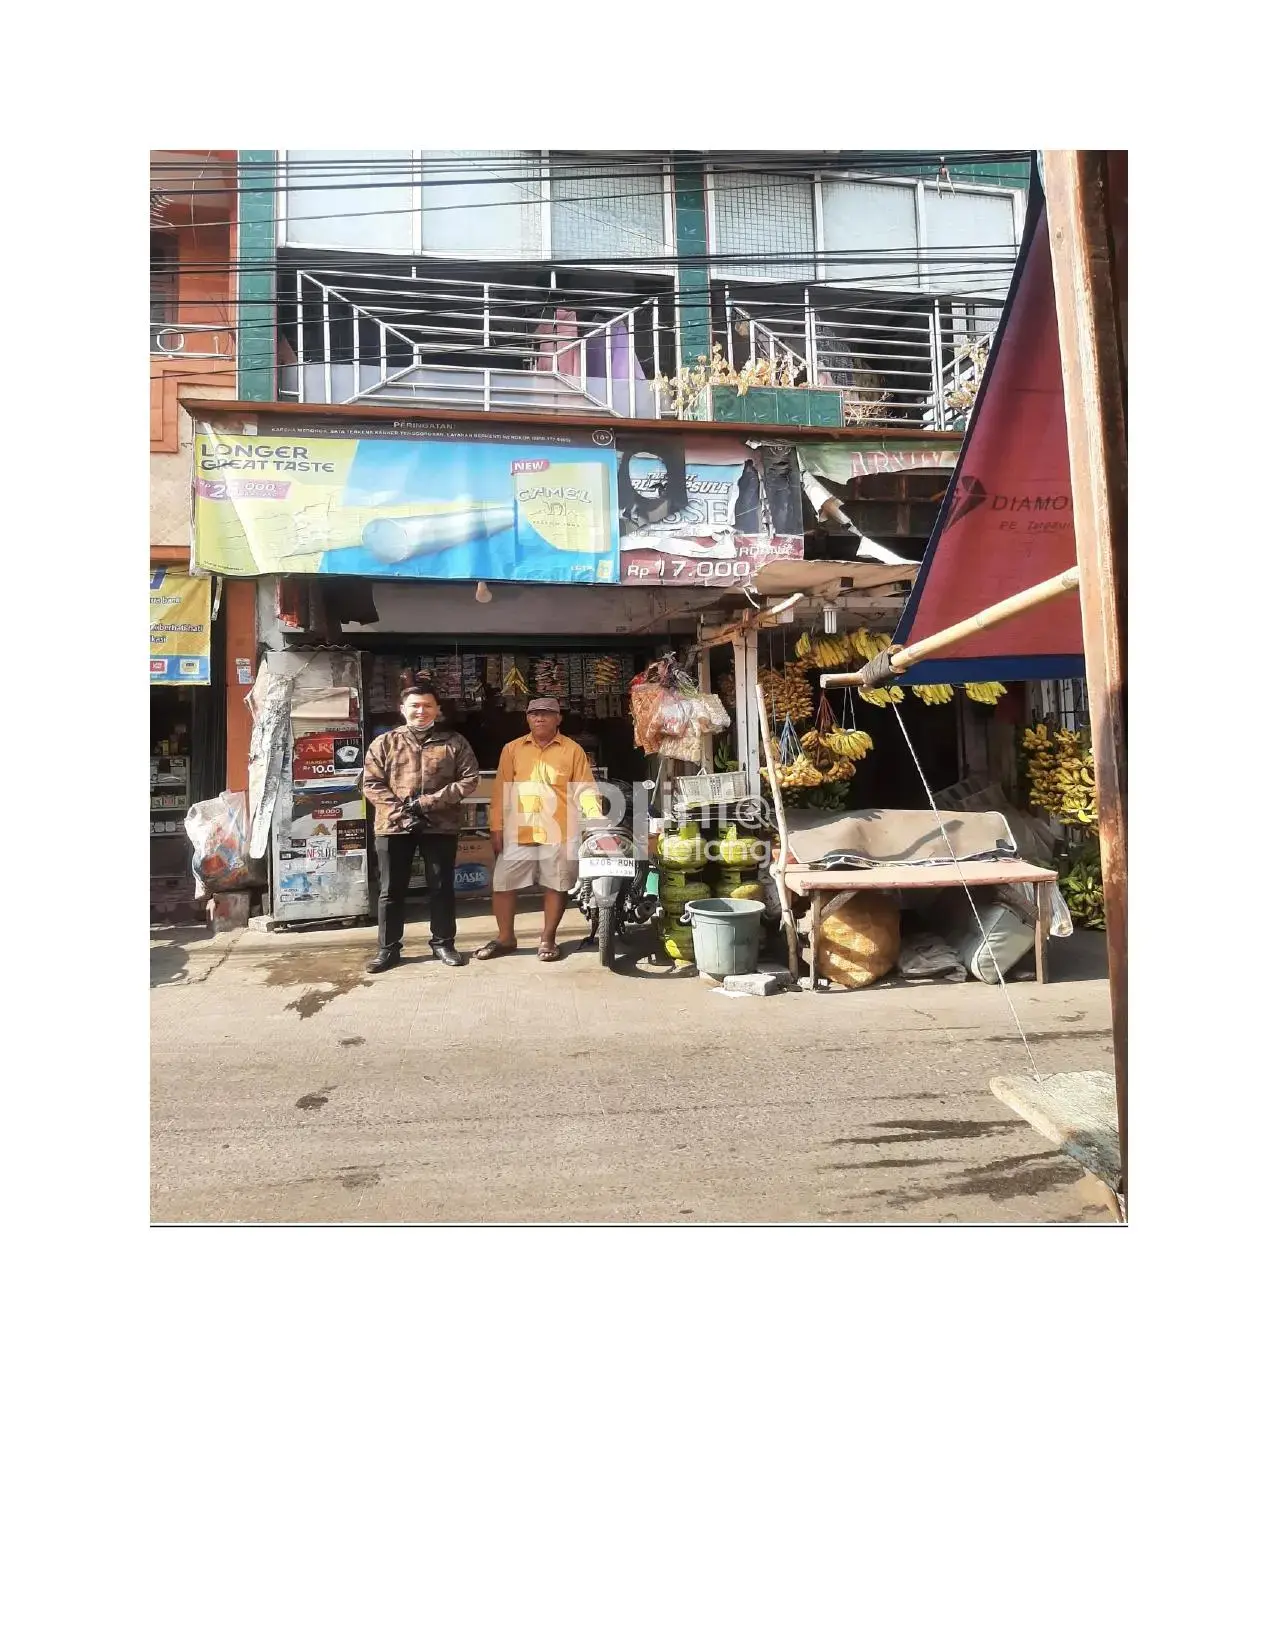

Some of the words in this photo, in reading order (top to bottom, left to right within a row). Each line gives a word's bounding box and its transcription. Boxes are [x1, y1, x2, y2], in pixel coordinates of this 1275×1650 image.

[201, 443, 309, 460] LONGER
[201, 459, 269, 471] GREAT
[273, 460, 335, 473] TASTE
[514, 461, 544, 471] NEW
[519, 486, 592, 504] CAMEL
[990, 495, 1070, 512] DIAMO
[627, 564, 650, 579] Rp
[312, 764, 335, 774] 10.0
